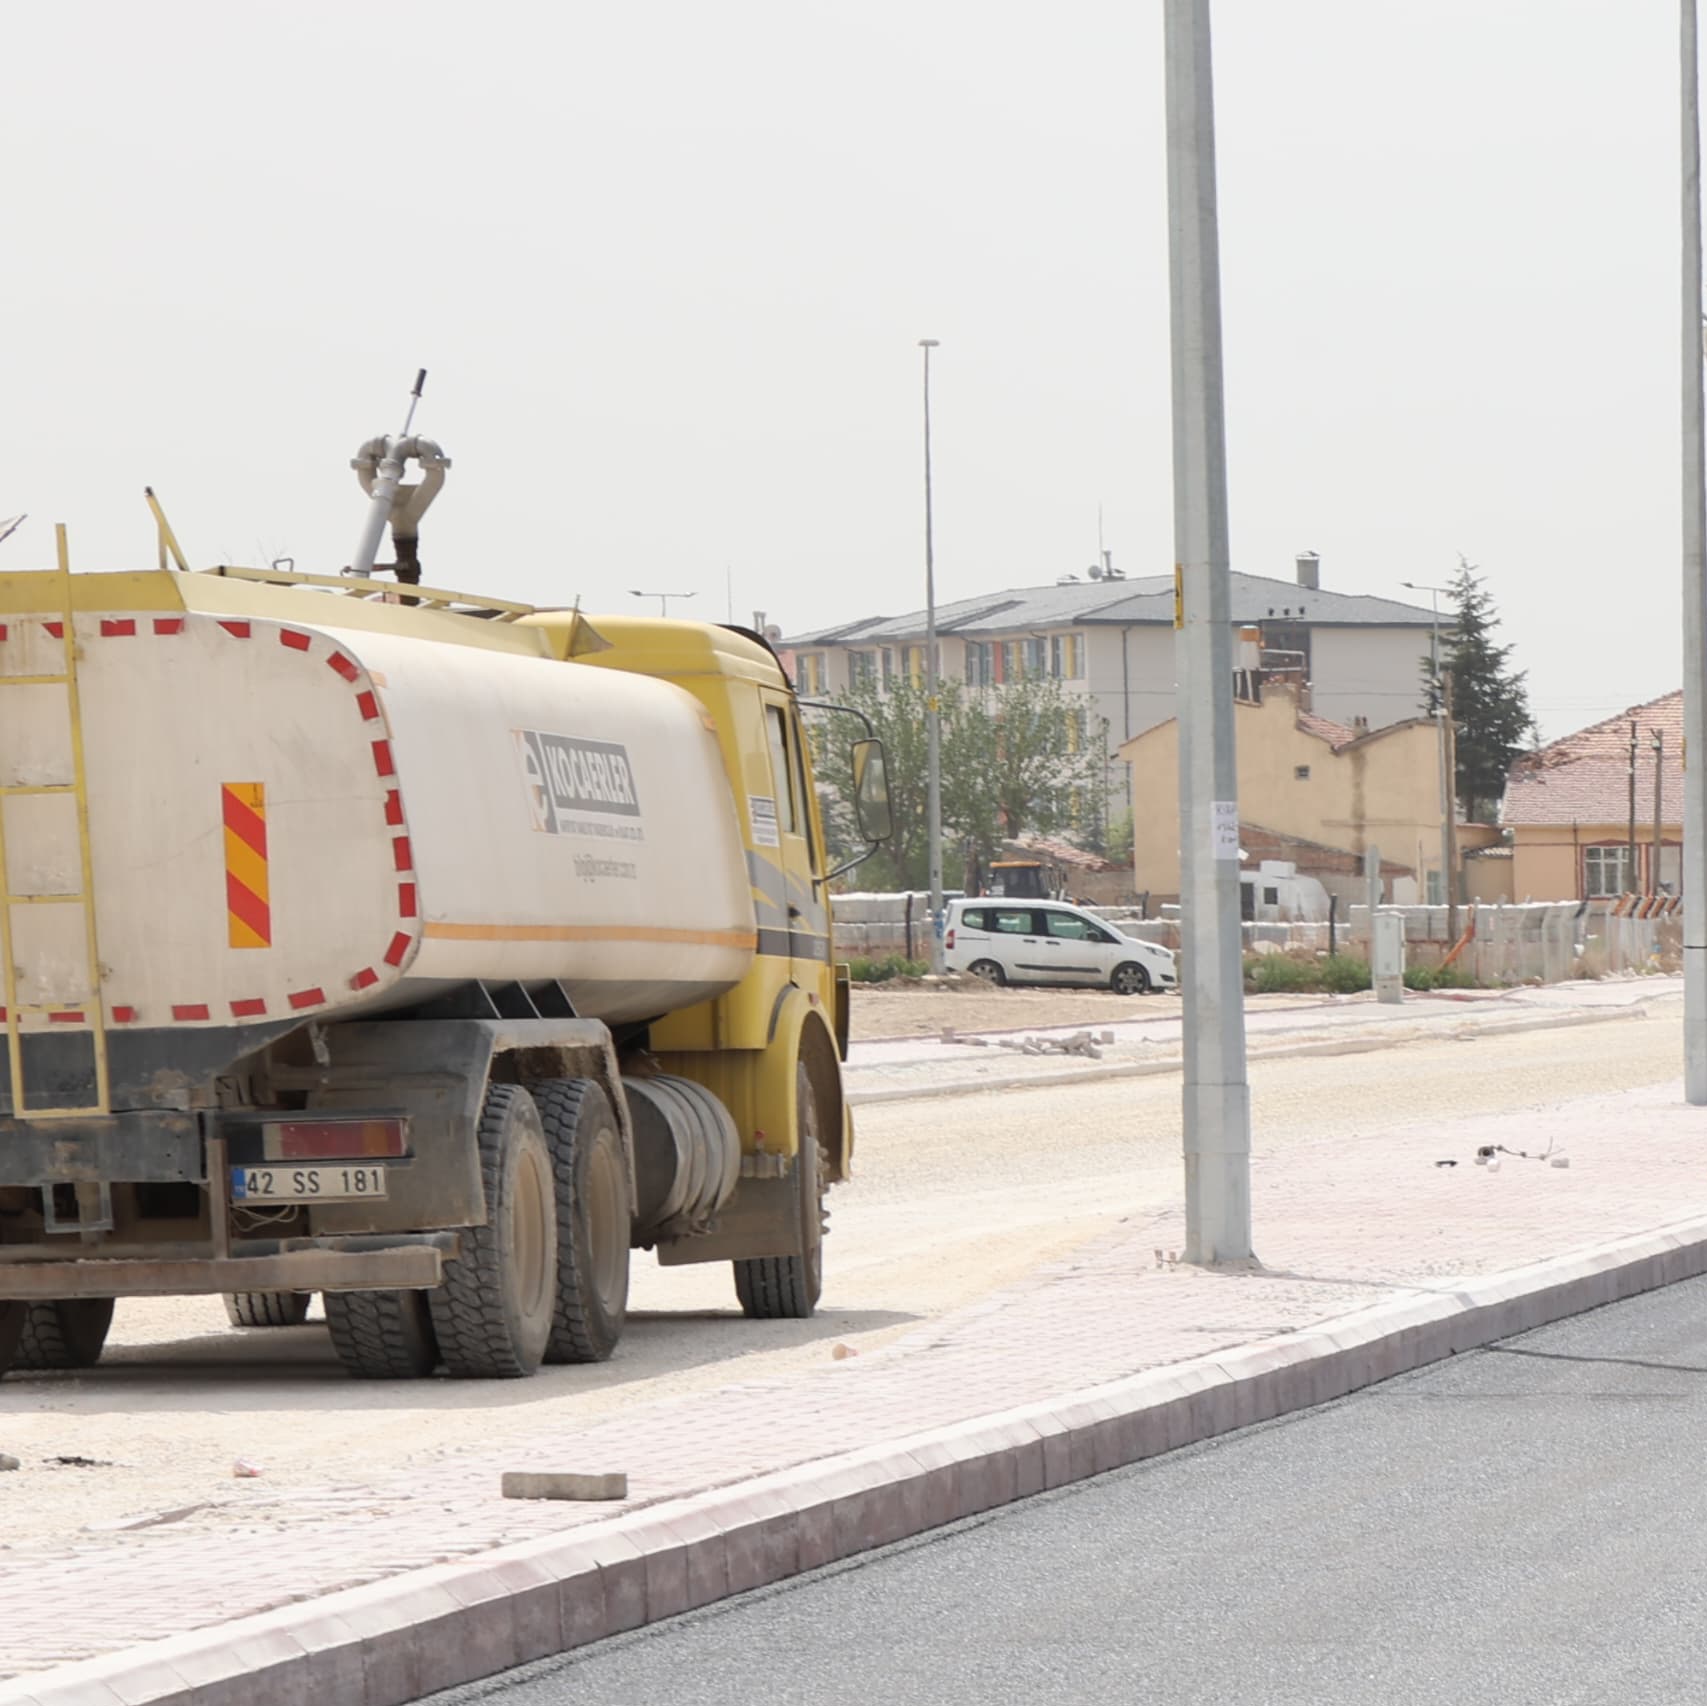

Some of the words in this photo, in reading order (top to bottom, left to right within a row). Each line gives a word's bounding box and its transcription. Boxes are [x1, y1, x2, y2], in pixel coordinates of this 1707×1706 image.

[545, 745, 635, 805] KOCAERLER
[247, 1172, 274, 1194] 42
[293, 1171, 320, 1193] SS
[341, 1169, 379, 1193] 181
